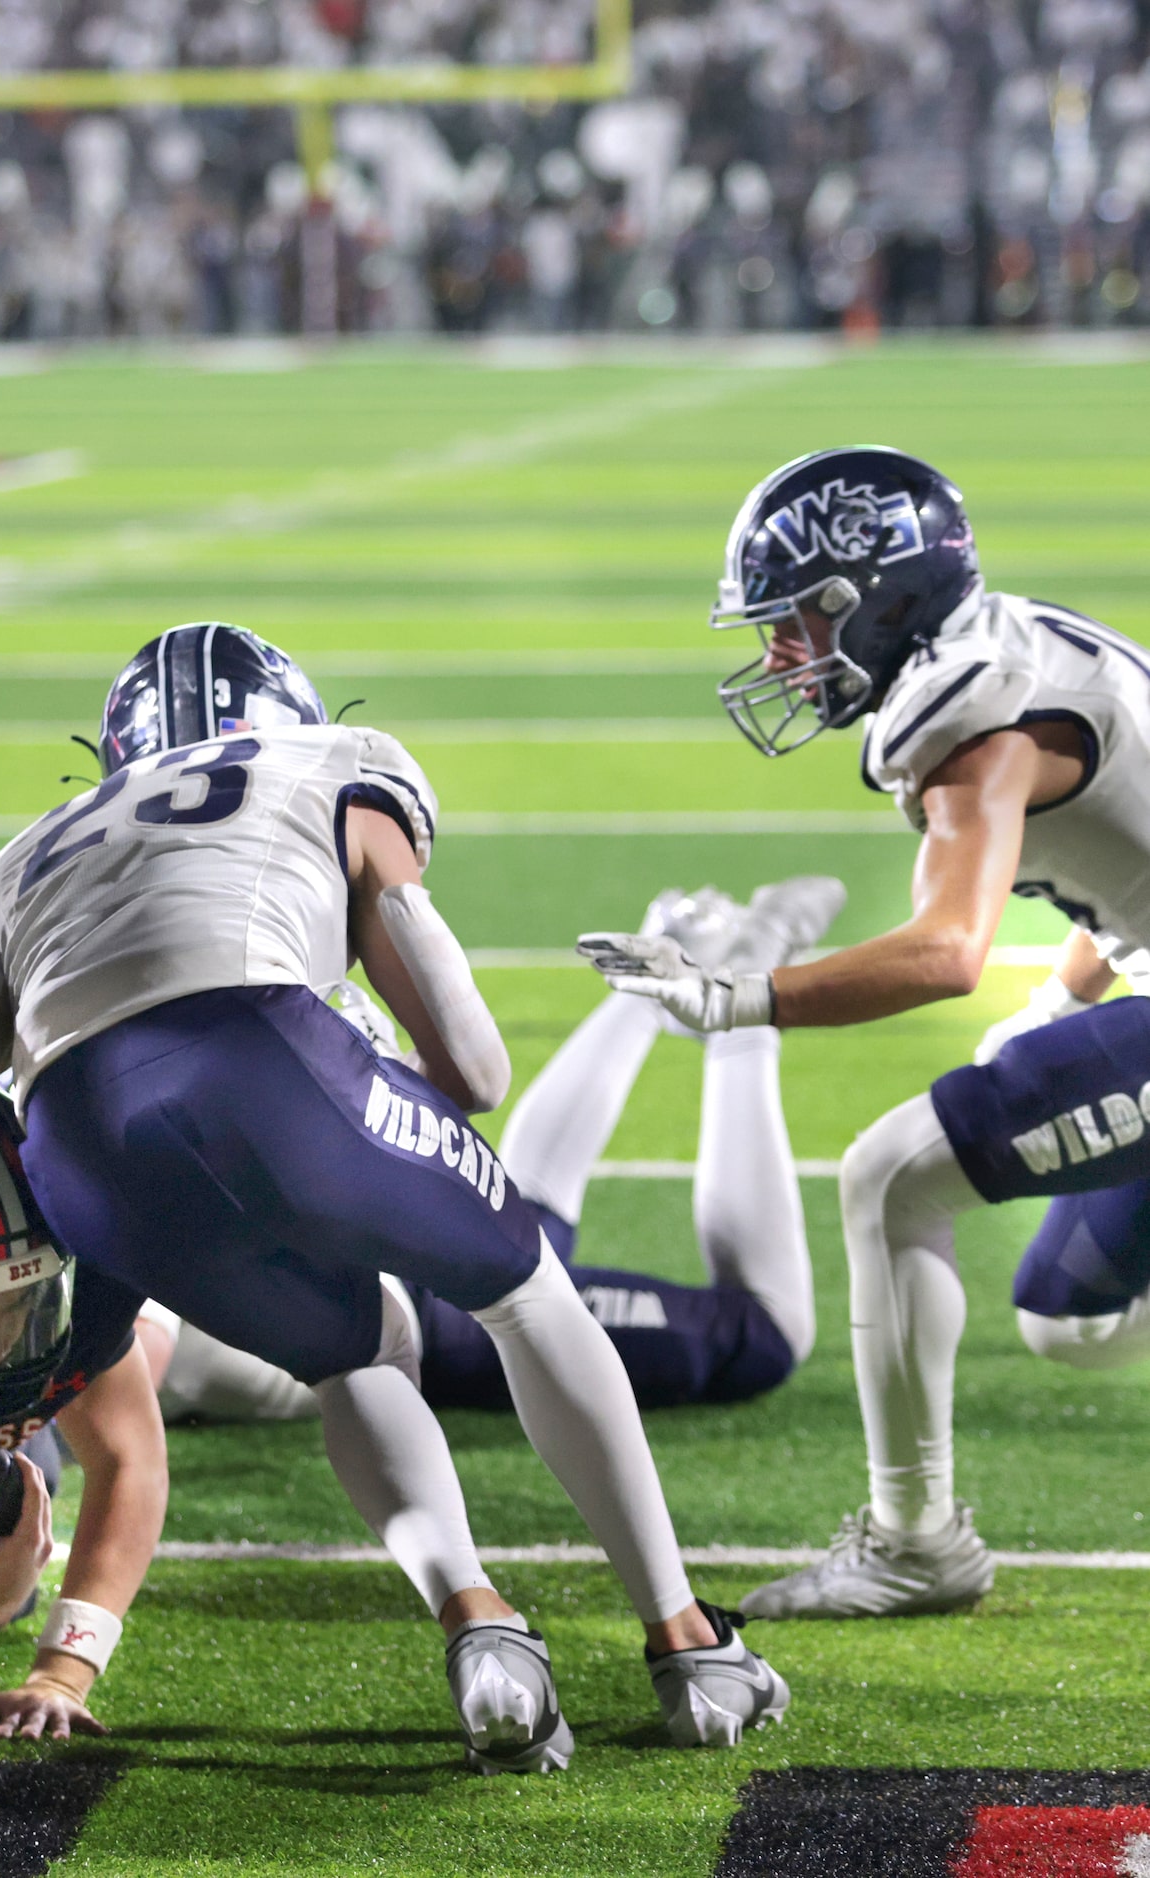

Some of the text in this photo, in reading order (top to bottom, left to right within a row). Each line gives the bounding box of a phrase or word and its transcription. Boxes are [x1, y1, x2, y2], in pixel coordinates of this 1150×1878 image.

[214, 677, 231, 708] 3
[15, 737, 264, 899] 23
[364, 1074, 506, 1212] WILDCATS
